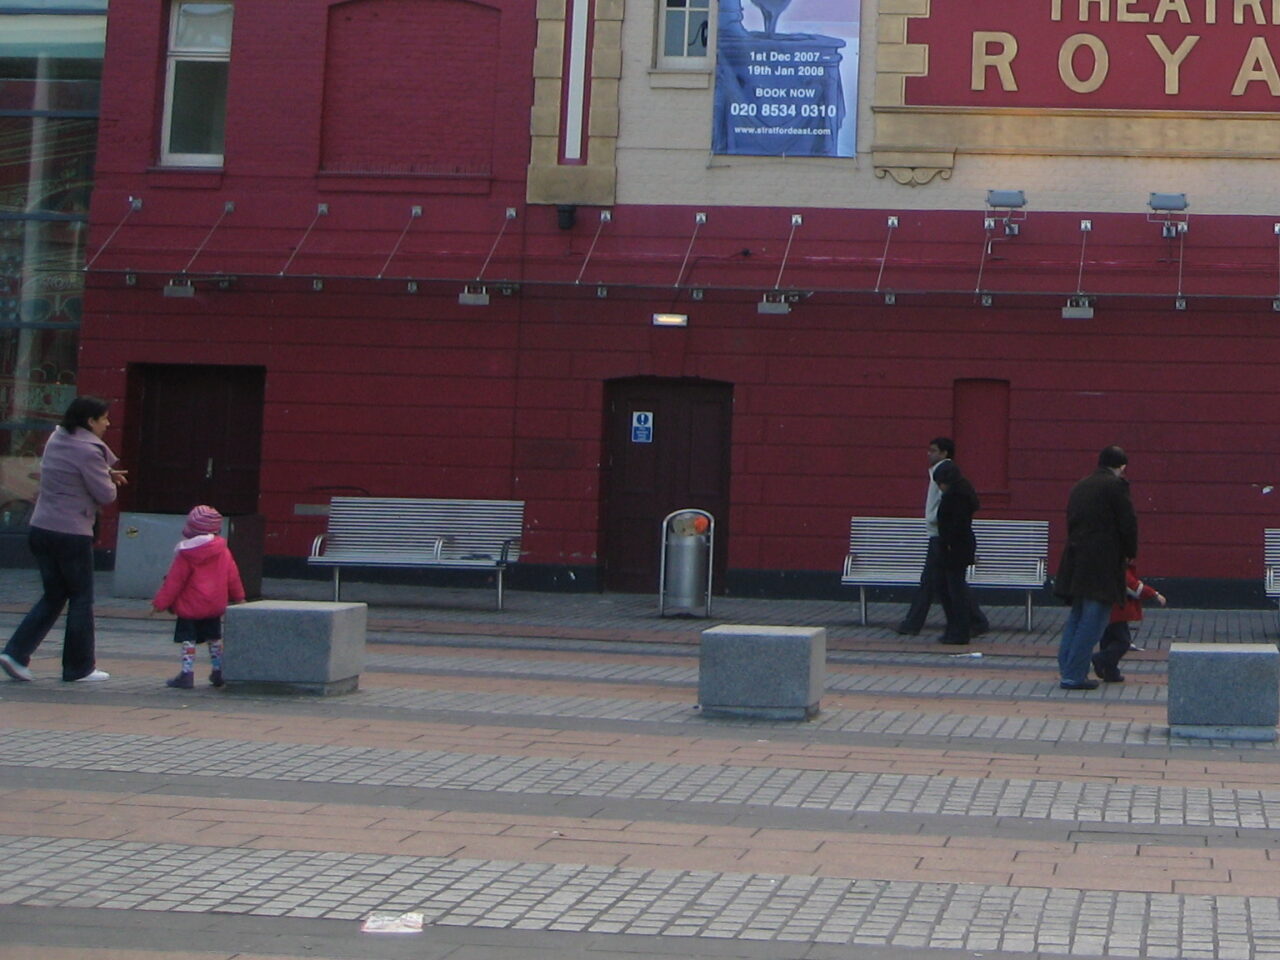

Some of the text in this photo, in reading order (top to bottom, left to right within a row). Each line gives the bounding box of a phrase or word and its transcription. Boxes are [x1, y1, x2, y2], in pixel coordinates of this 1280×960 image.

[750, 52, 767, 61] 1st
[770, 52, 791, 62] Dec
[794, 52, 820, 62] 2007
[748, 65, 824, 76] 19th Jan 2008
[755, 88, 815, 98] BOOK NOW
[730, 103, 837, 117] 020 8534 0310
[734, 126, 831, 135] www.stratfordeast.com
